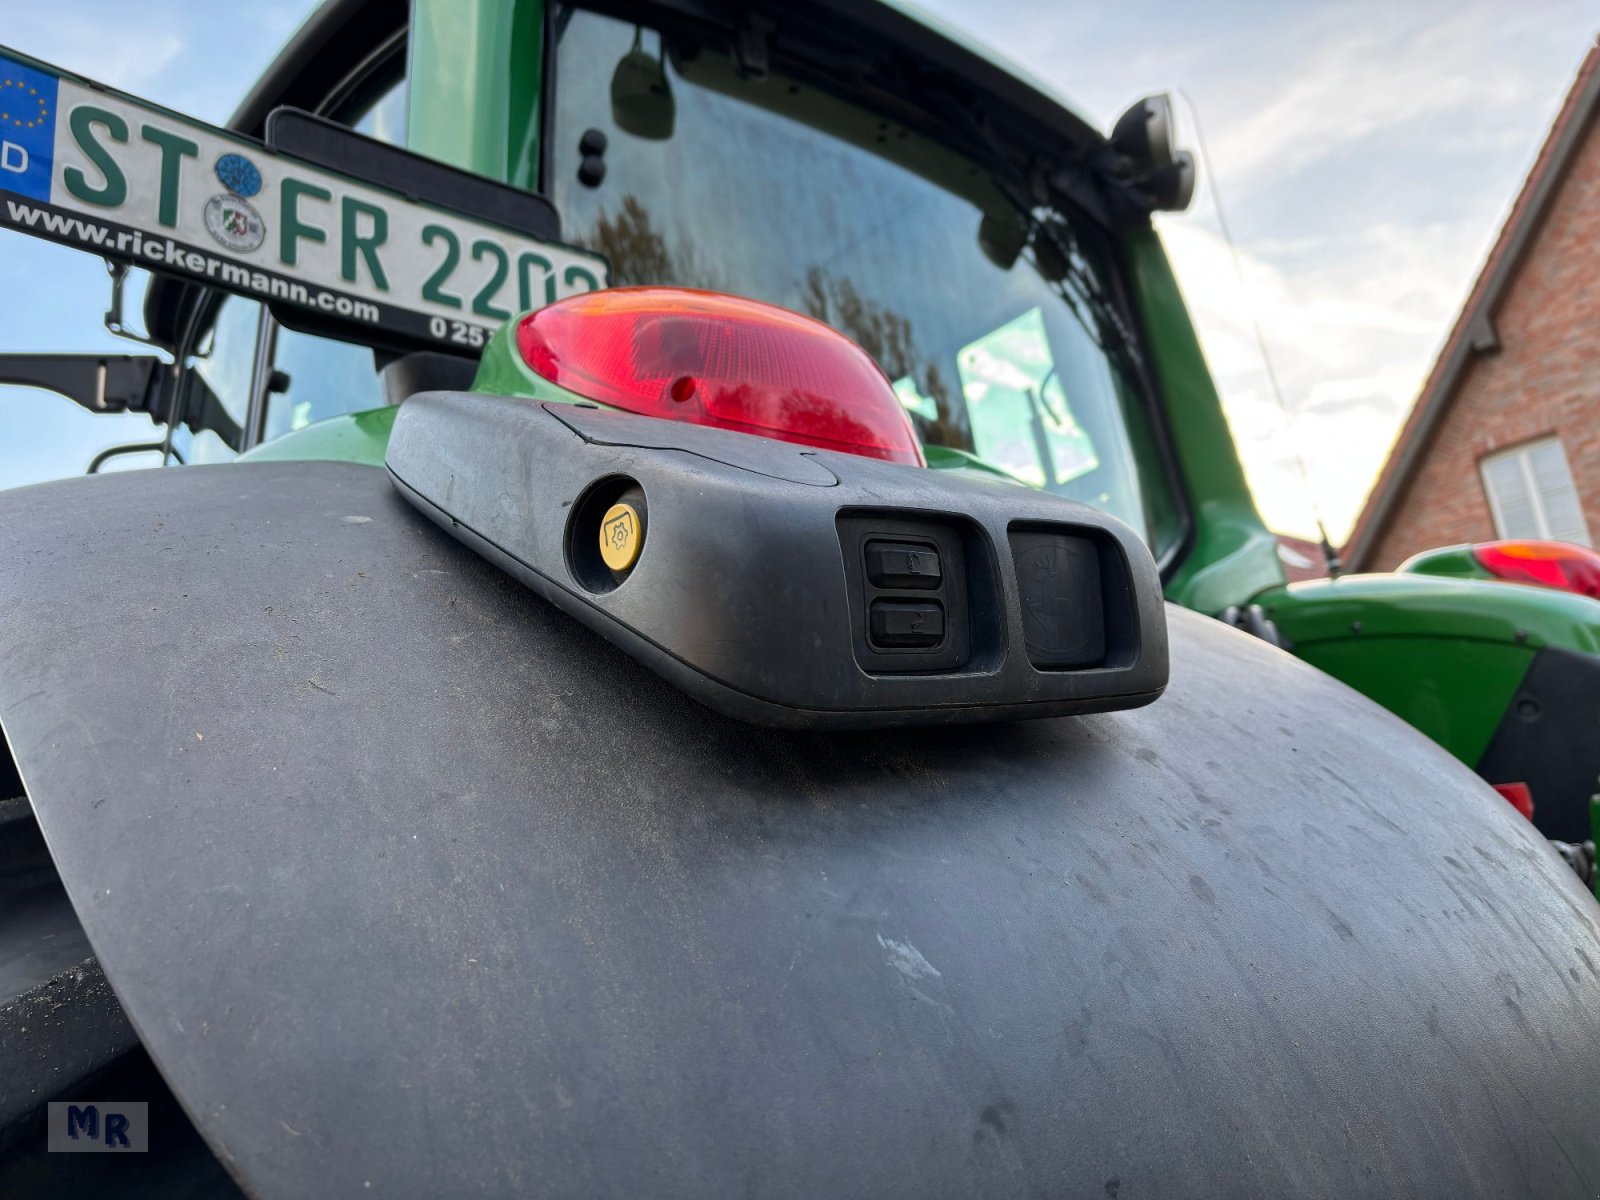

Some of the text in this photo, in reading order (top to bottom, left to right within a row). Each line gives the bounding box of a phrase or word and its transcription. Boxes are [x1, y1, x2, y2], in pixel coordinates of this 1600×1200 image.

[1, 141, 29, 174] D
[63, 105, 199, 229] ST
[280, 176, 389, 292] FR
[6, 200, 380, 323] www.rickermann.com
